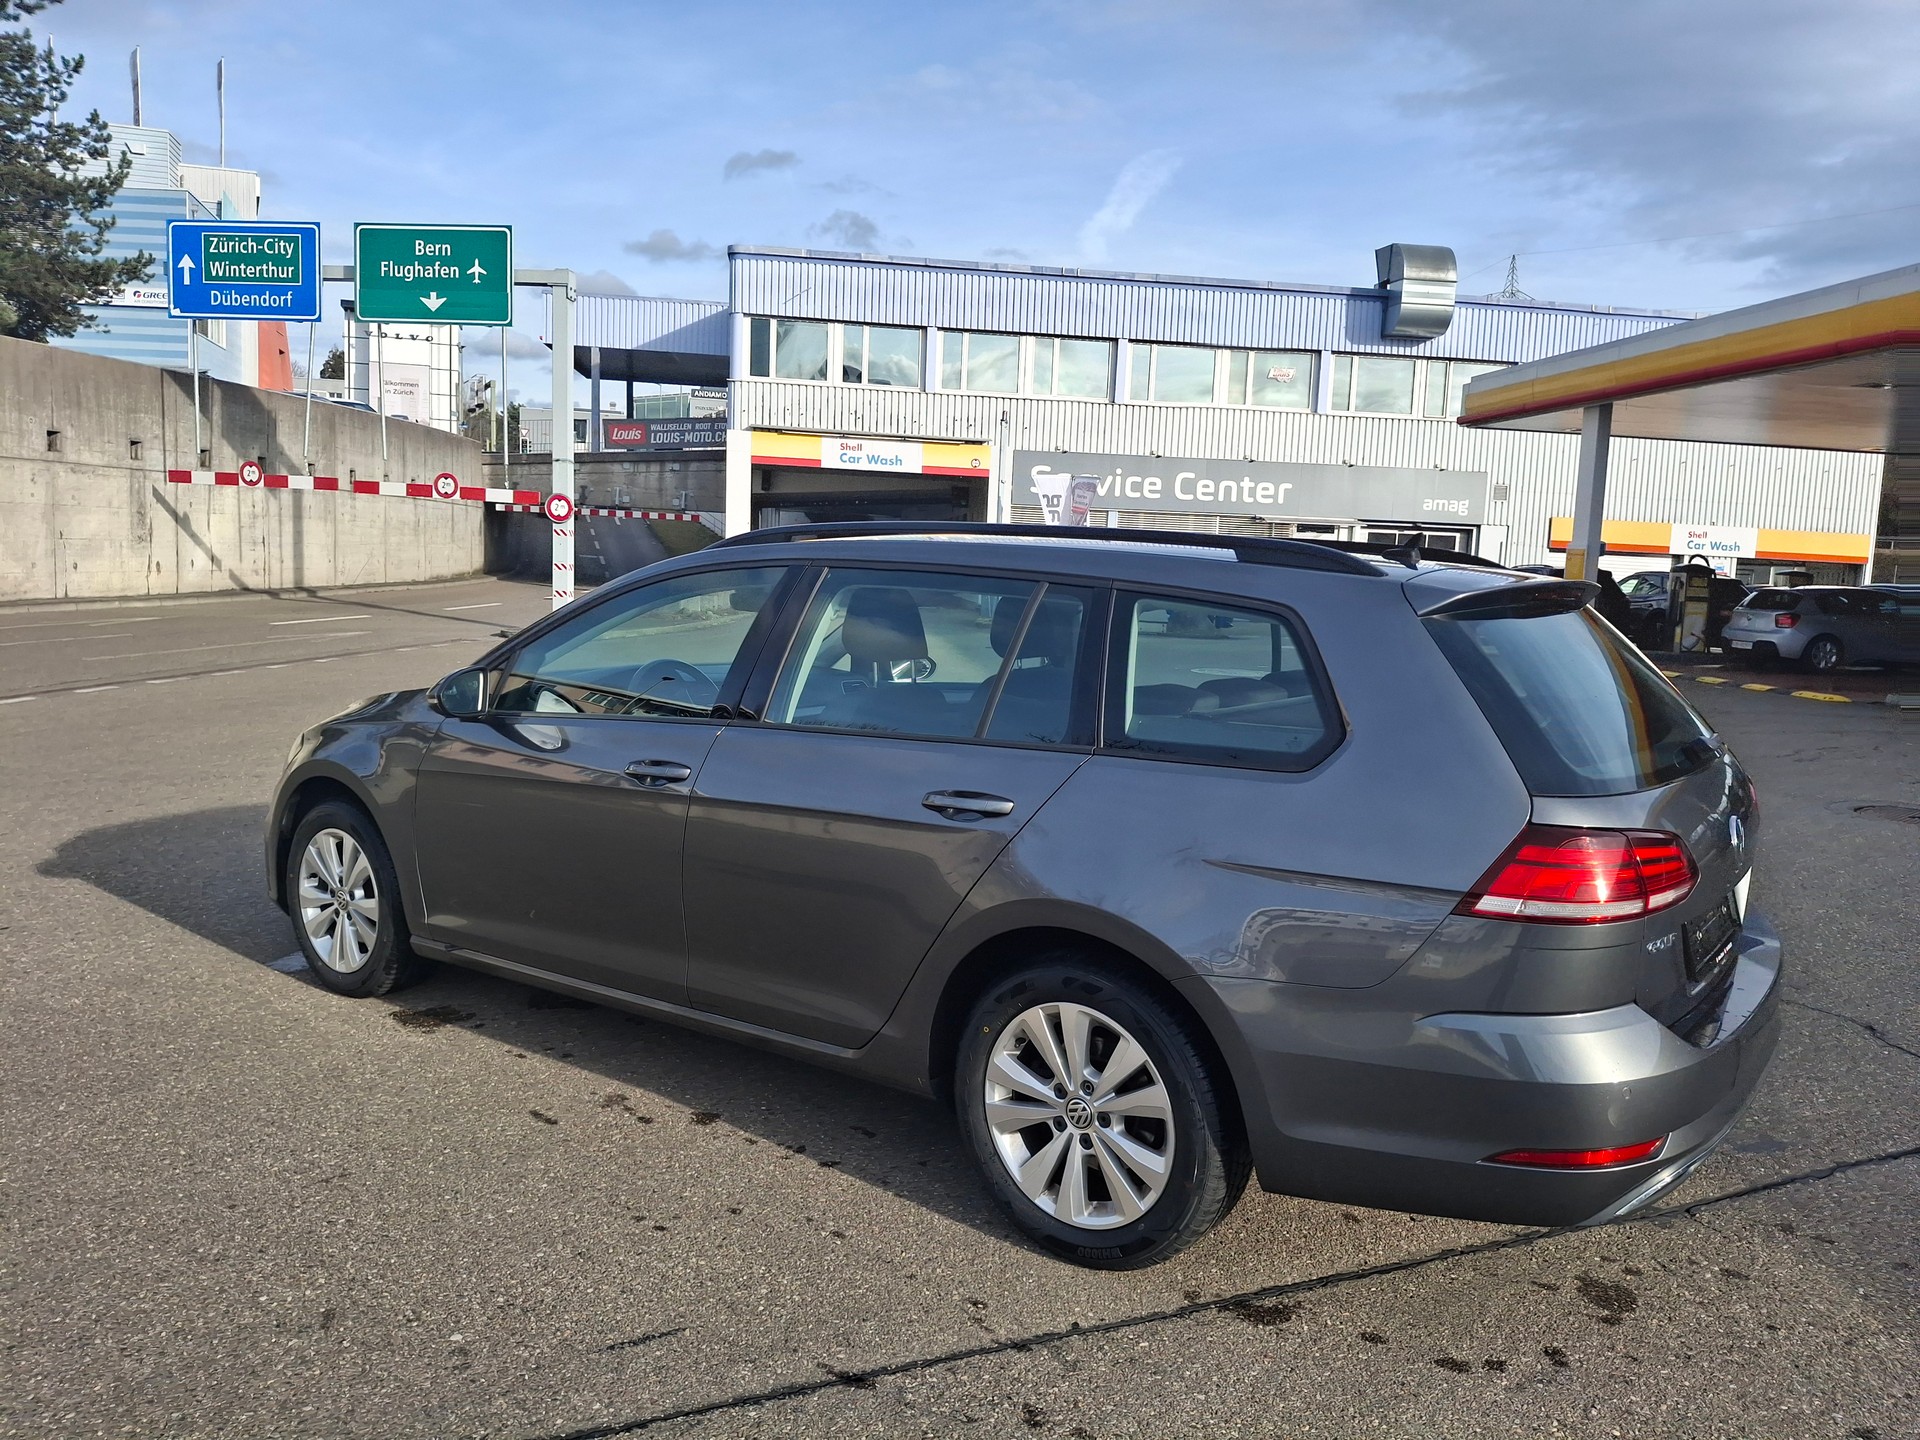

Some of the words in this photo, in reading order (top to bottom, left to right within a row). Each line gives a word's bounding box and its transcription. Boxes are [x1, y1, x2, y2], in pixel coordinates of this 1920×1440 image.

[209, 237, 294, 258] Zürich-City
[415, 240, 451, 256] Bern
[209, 261, 294, 278] Winterthur
[380, 261, 460, 282] Flughafen
[210, 290, 293, 307] Dübendorf
[364, 330, 434, 342] VOLVO
[383, 380, 420, 388] älkommen
[694, 390, 727, 399] ANDIAMO
[650, 423, 692, 431] WALLISELLEN
[612, 428, 642, 440] Louis
[840, 443, 863, 452] Shell
[839, 453, 862, 464] Car
[866, 454, 903, 466] Wash
[1174, 471, 1293, 505] Center
[1422, 498, 1470, 516] amag
[1688, 531, 1708, 539] Shell
[1687, 540, 1706, 550] Car
[1710, 541, 1741, 552] Wash
